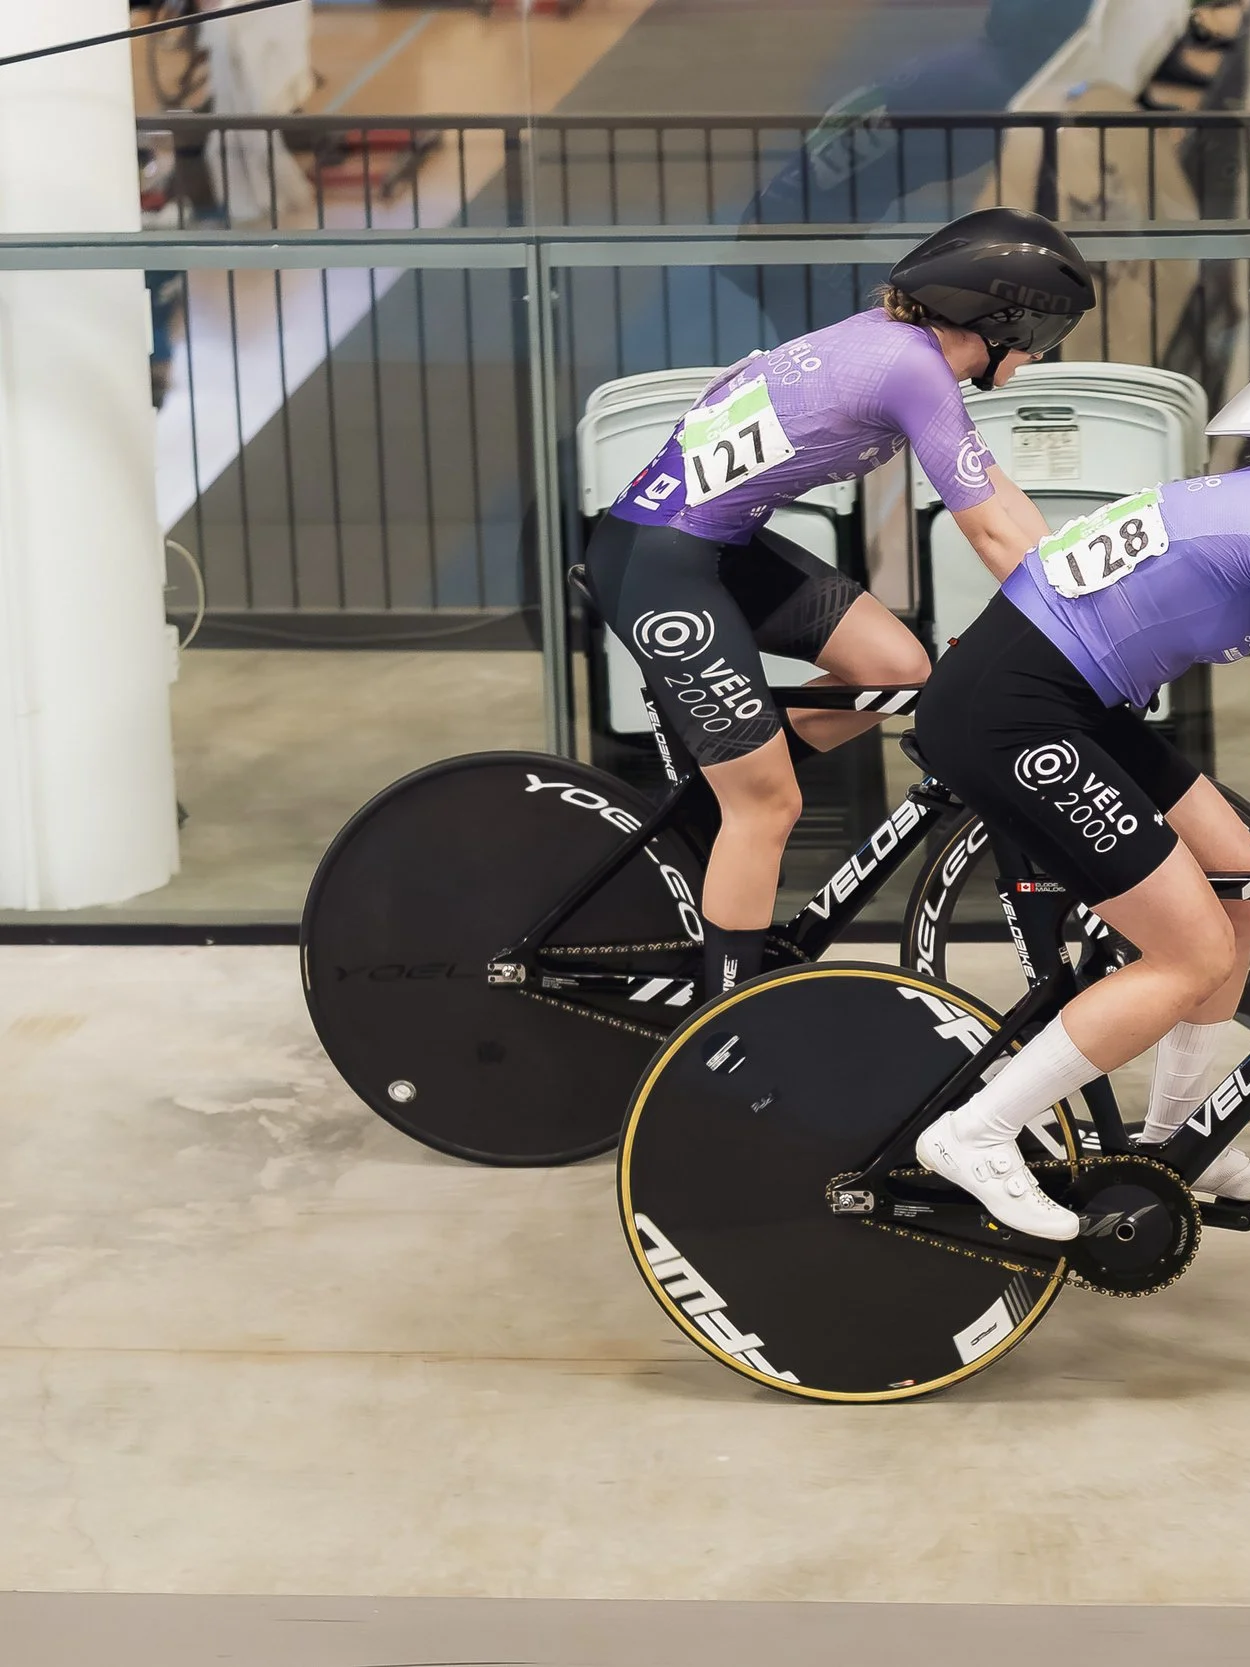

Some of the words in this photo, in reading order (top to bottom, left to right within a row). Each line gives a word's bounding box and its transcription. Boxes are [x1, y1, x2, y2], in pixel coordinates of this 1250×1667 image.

[990, 279, 1072, 313] GIRO
[692, 420, 765, 494] 127
[1065, 518, 1149, 587] 128
[664, 673, 732, 733] 2000
[646, 701, 678, 782] VELOBIKE
[1054, 792, 1118, 854] 2000
[806, 799, 928, 919] VELOB
[999, 892, 1037, 979] VELOBIKE
